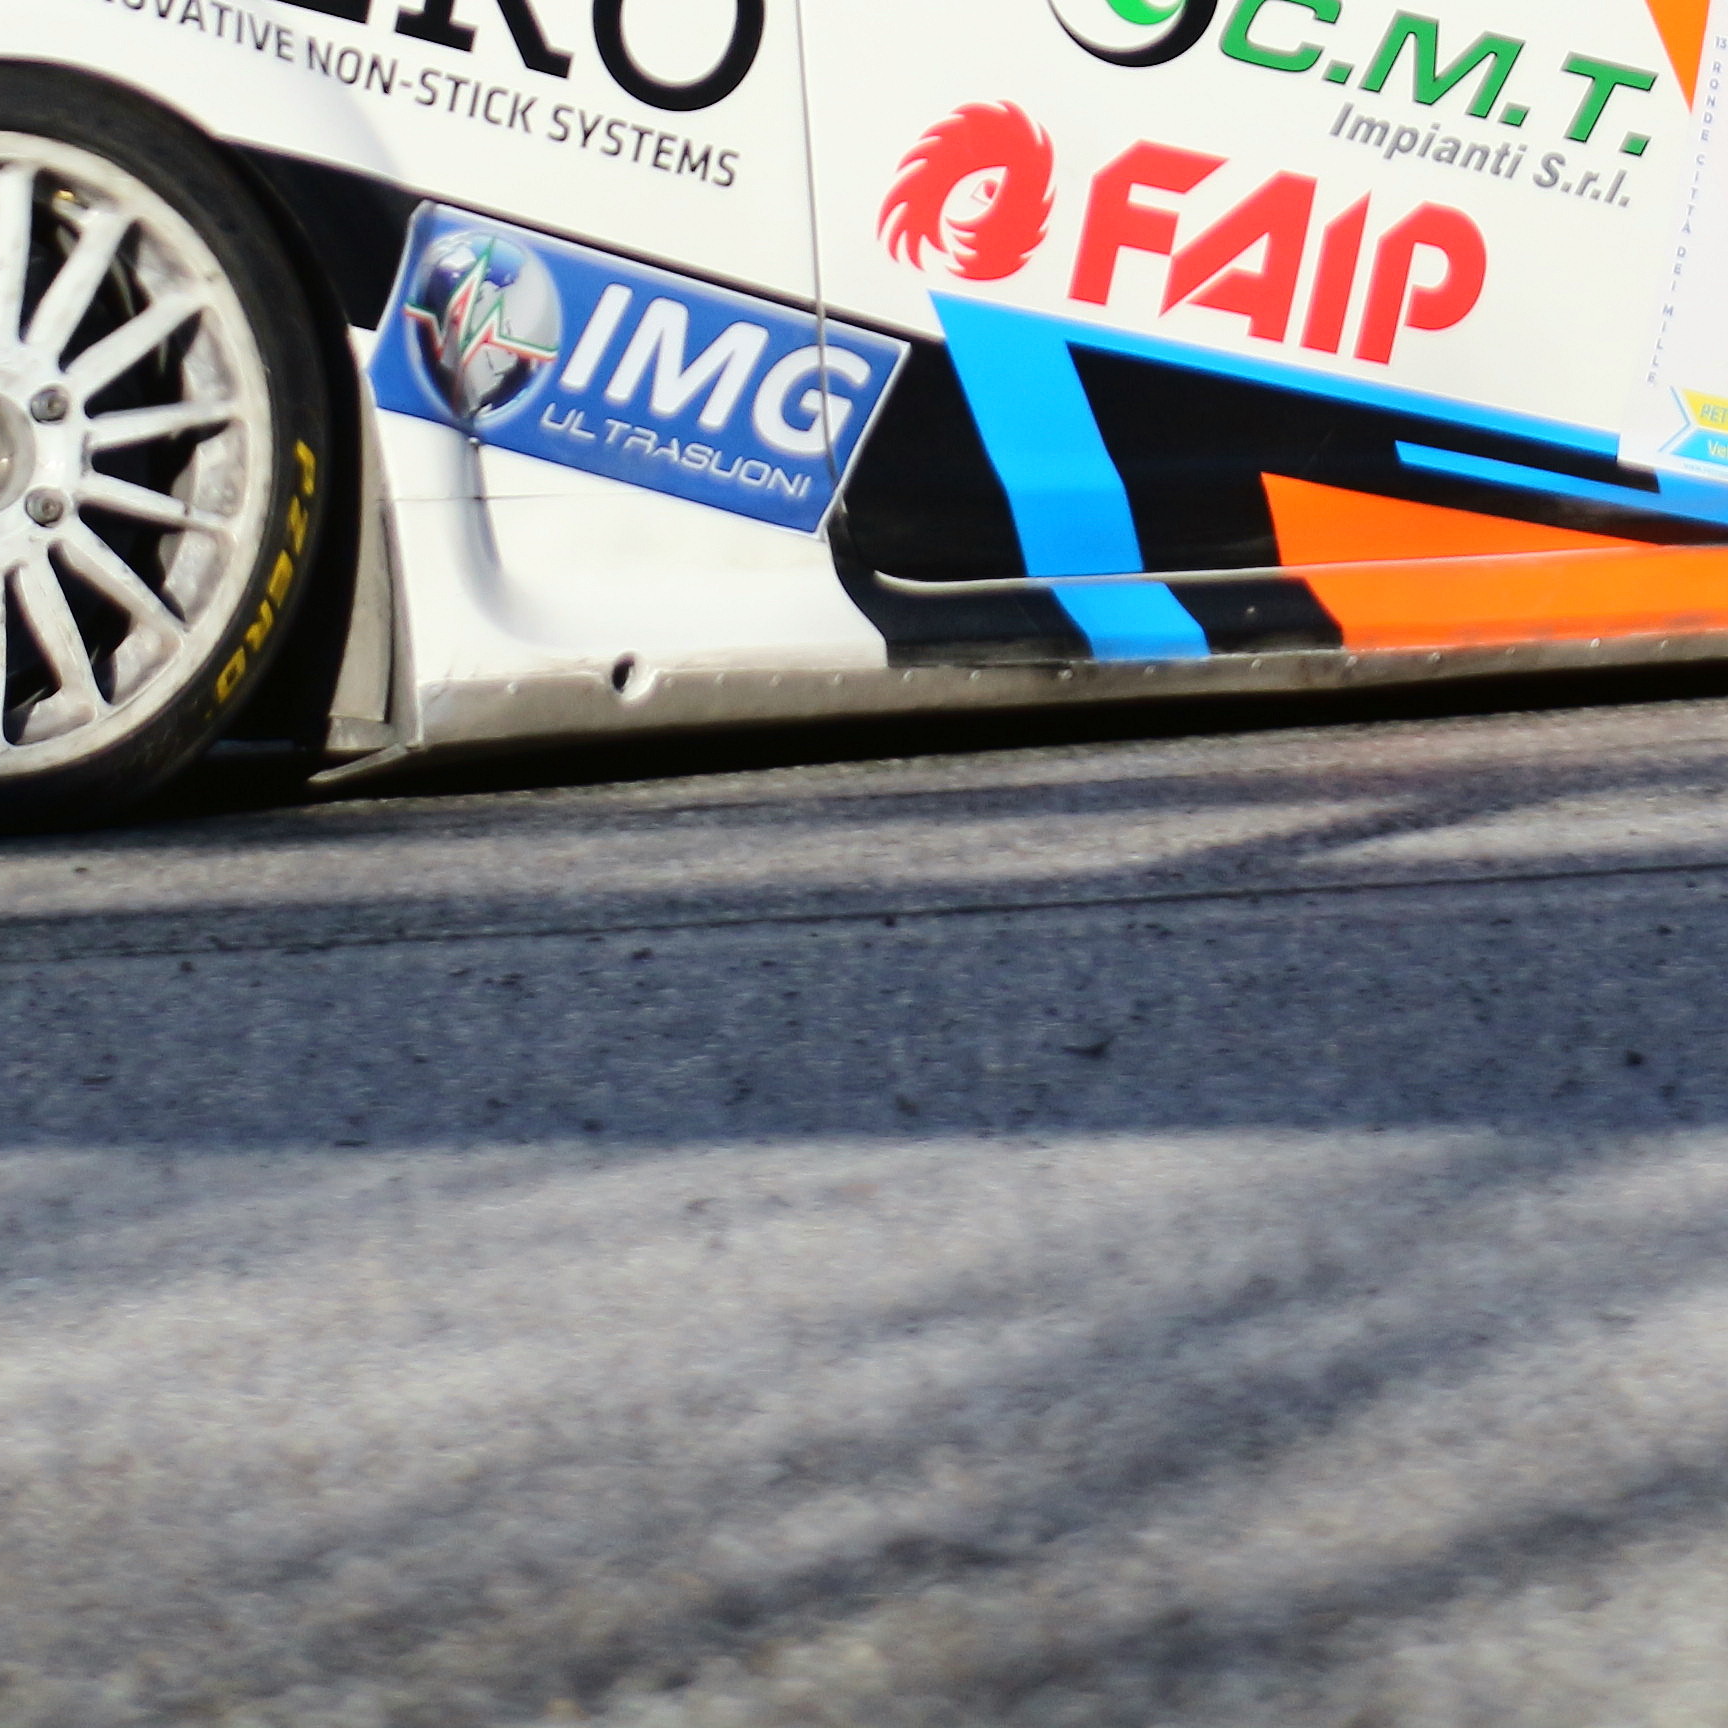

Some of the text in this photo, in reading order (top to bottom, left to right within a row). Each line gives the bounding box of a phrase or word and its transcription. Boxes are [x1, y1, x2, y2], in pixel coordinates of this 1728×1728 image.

[306, 32, 537, 135] NON-STICK
[547, 104, 742, 189] SYSTEMS
[1700, 61, 1722, 142] RONDE
[1328, 101, 1634, 209] Impianti S.r.l.
[1068, 139, 1488, 365] FAIP
[1671, 245, 1687, 293] DEI
[559, 281, 873, 457] IMG
[1646, 302, 1675, 385] MILLE
[540, 402, 814, 499] ULTRASUONI
